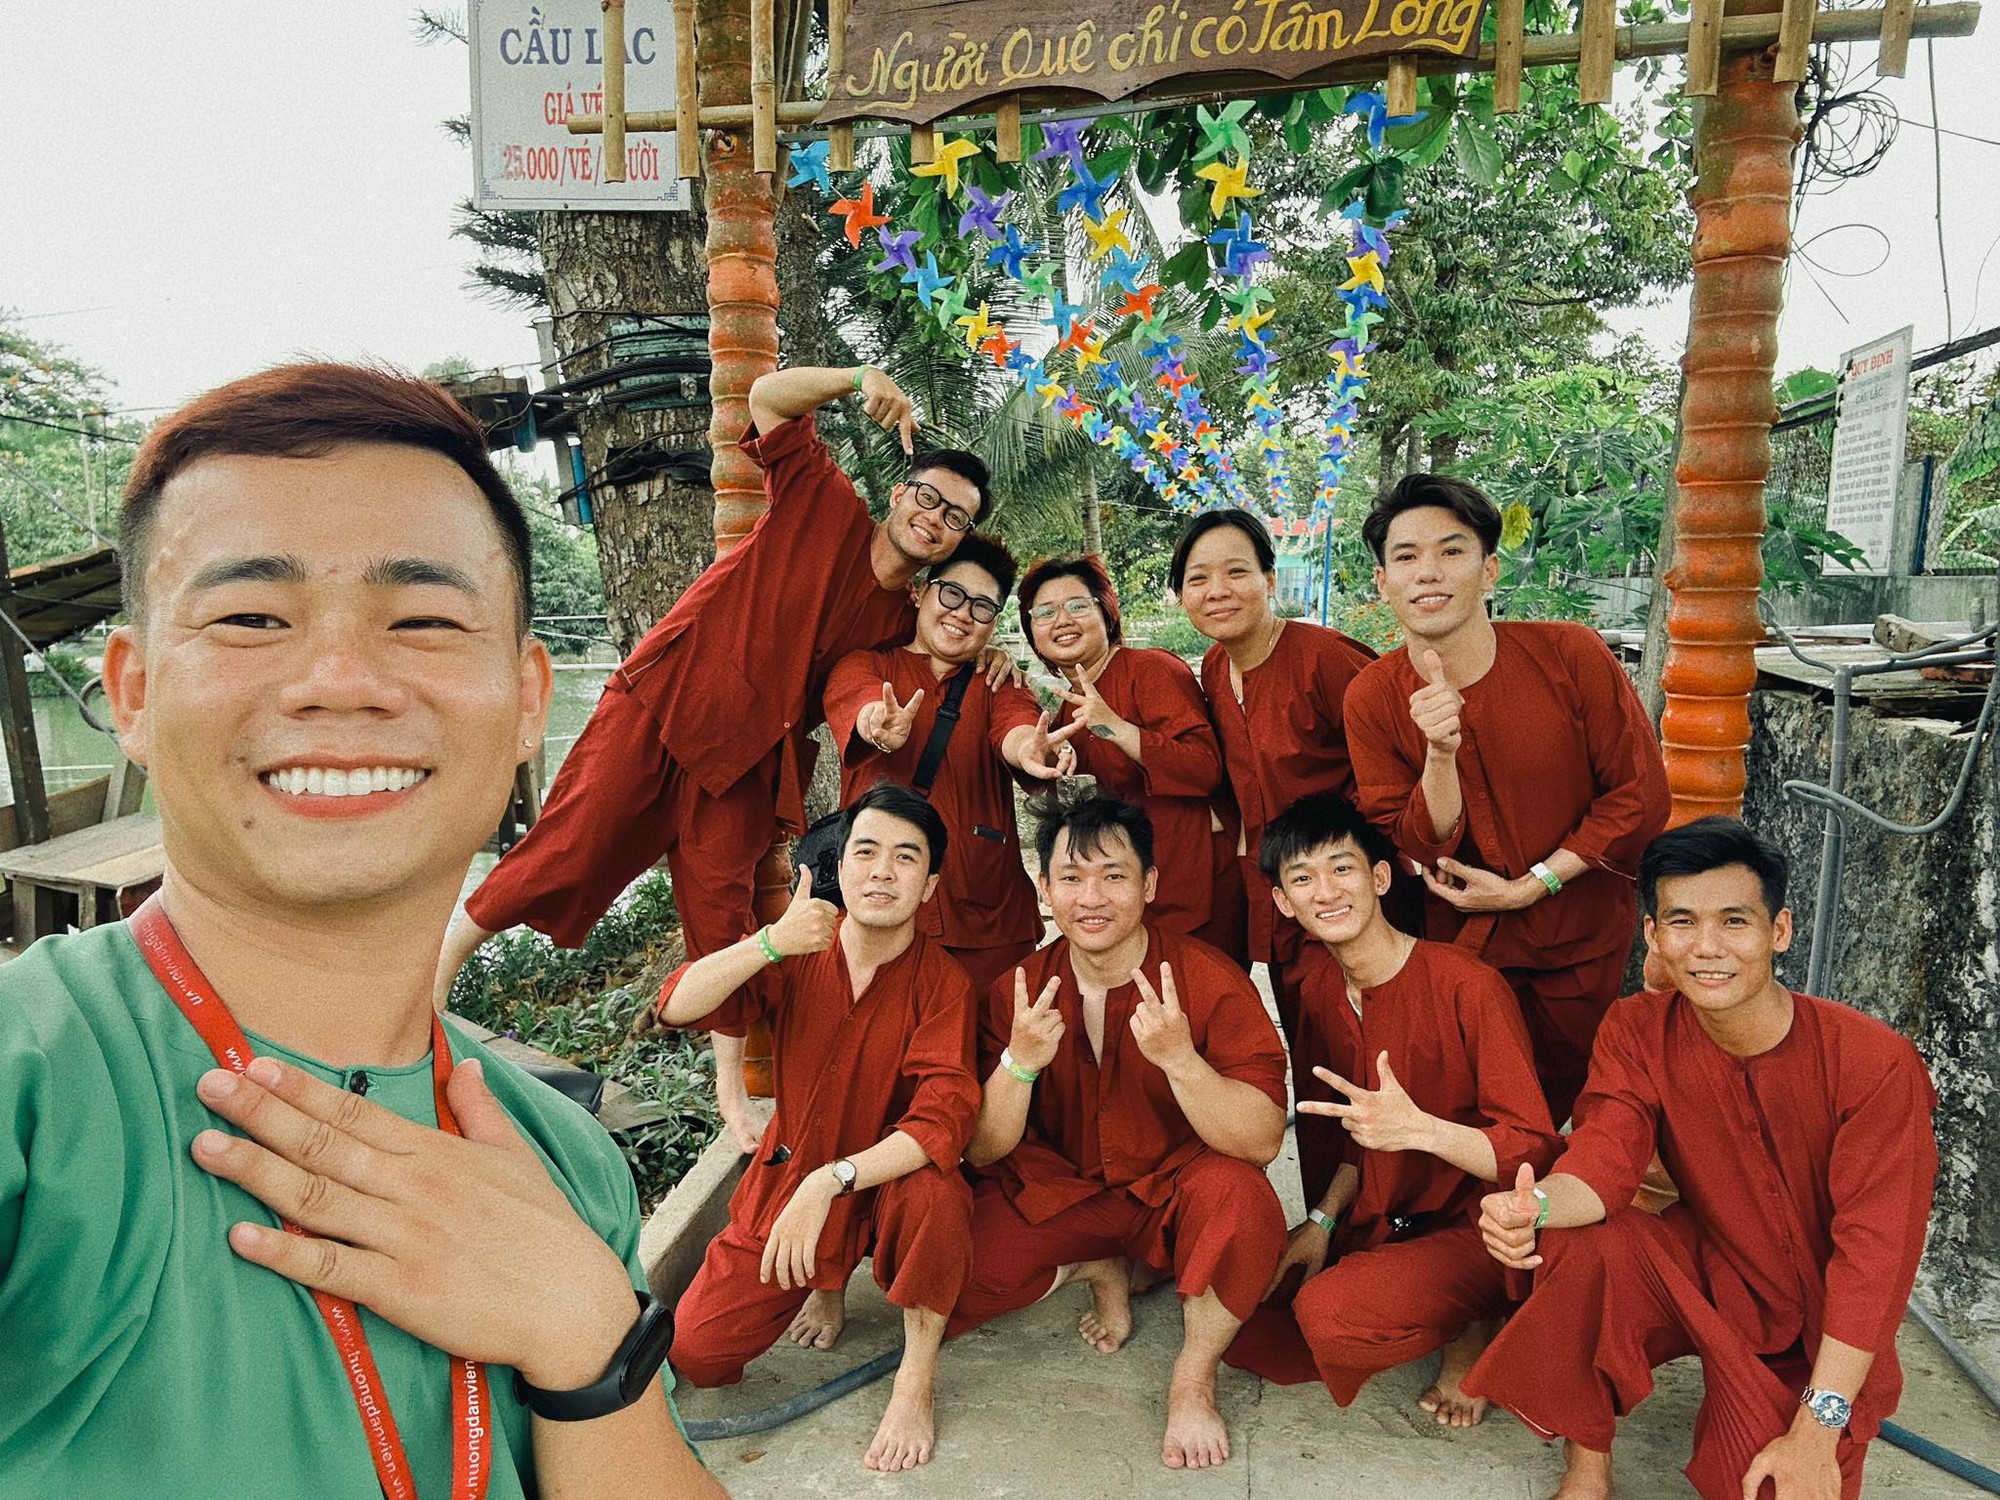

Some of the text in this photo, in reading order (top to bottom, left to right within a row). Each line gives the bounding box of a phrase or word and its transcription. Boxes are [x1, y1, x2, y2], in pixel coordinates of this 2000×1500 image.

[500, 6, 656, 65] CẦU LC
[999, 19, 1097, 86] Quê
[1190, 0, 1248, 58] có
[544, 82, 574, 125] GIÁ
